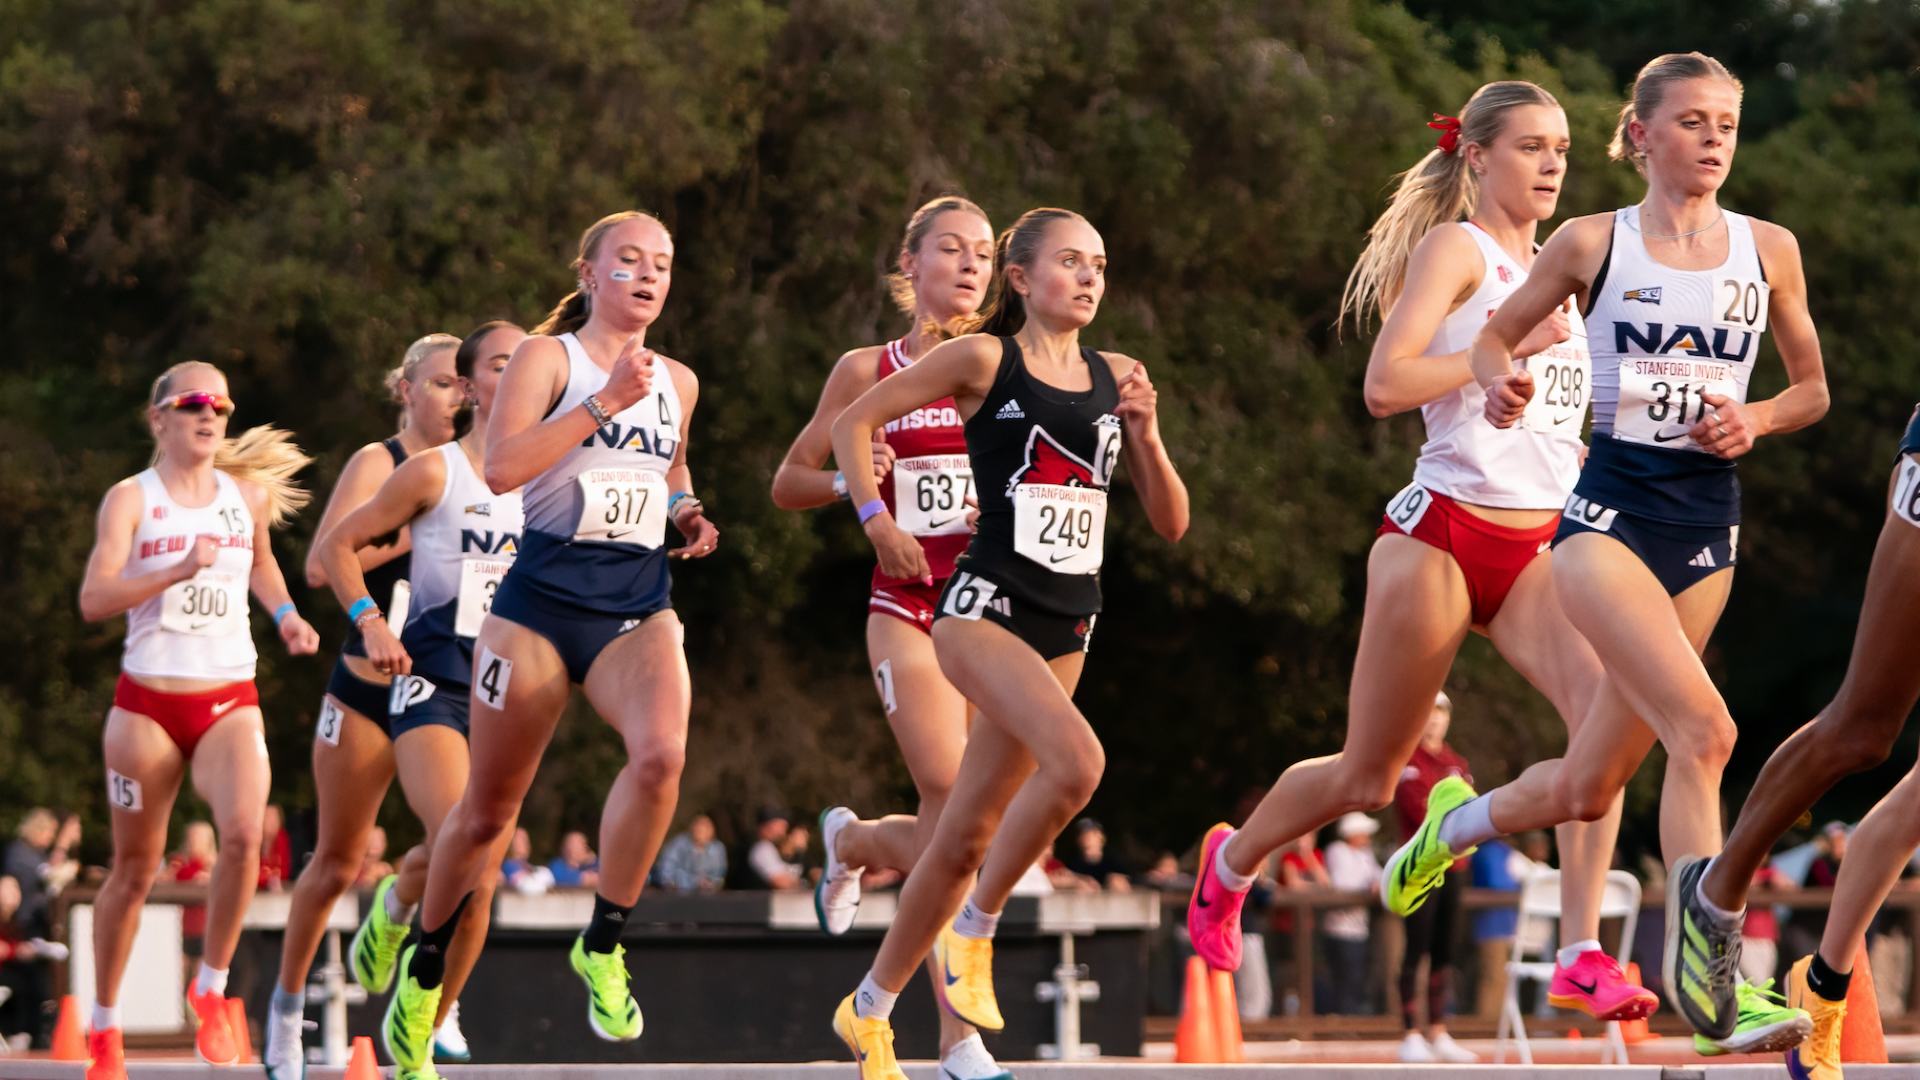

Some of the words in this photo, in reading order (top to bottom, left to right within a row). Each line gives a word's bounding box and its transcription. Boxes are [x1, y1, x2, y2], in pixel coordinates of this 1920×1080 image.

[1723, 279, 1759, 326] 20
[1612, 321, 1751, 362] NAU
[1545, 364, 1583, 409] 298
[1635, 360, 1691, 377] STANFORD
[1694, 364, 1726, 381] INVITE
[657, 393, 676, 437] 4
[996, 410, 1026, 420] adidas
[1648, 381, 1706, 425] 311
[582, 421, 676, 461] NAU
[1102, 431, 1118, 483] 6
[591, 470, 632, 483] STANFORD
[905, 458, 951, 472] STANFORD
[605, 487, 649, 525] 317
[917, 473, 974, 511] 637
[1029, 486, 1076, 502] STANFORD
[1078, 491, 1102, 506] INVITE
[1390, 485, 1424, 525] 19
[219, 507, 245, 533] 15
[1039, 505, 1092, 549] 249
[140, 534, 188, 560] NEW
[182, 585, 227, 617] 300
[955, 574, 980, 615] 6
[481, 658, 501, 703] 4
[113, 774, 134, 807] 15
